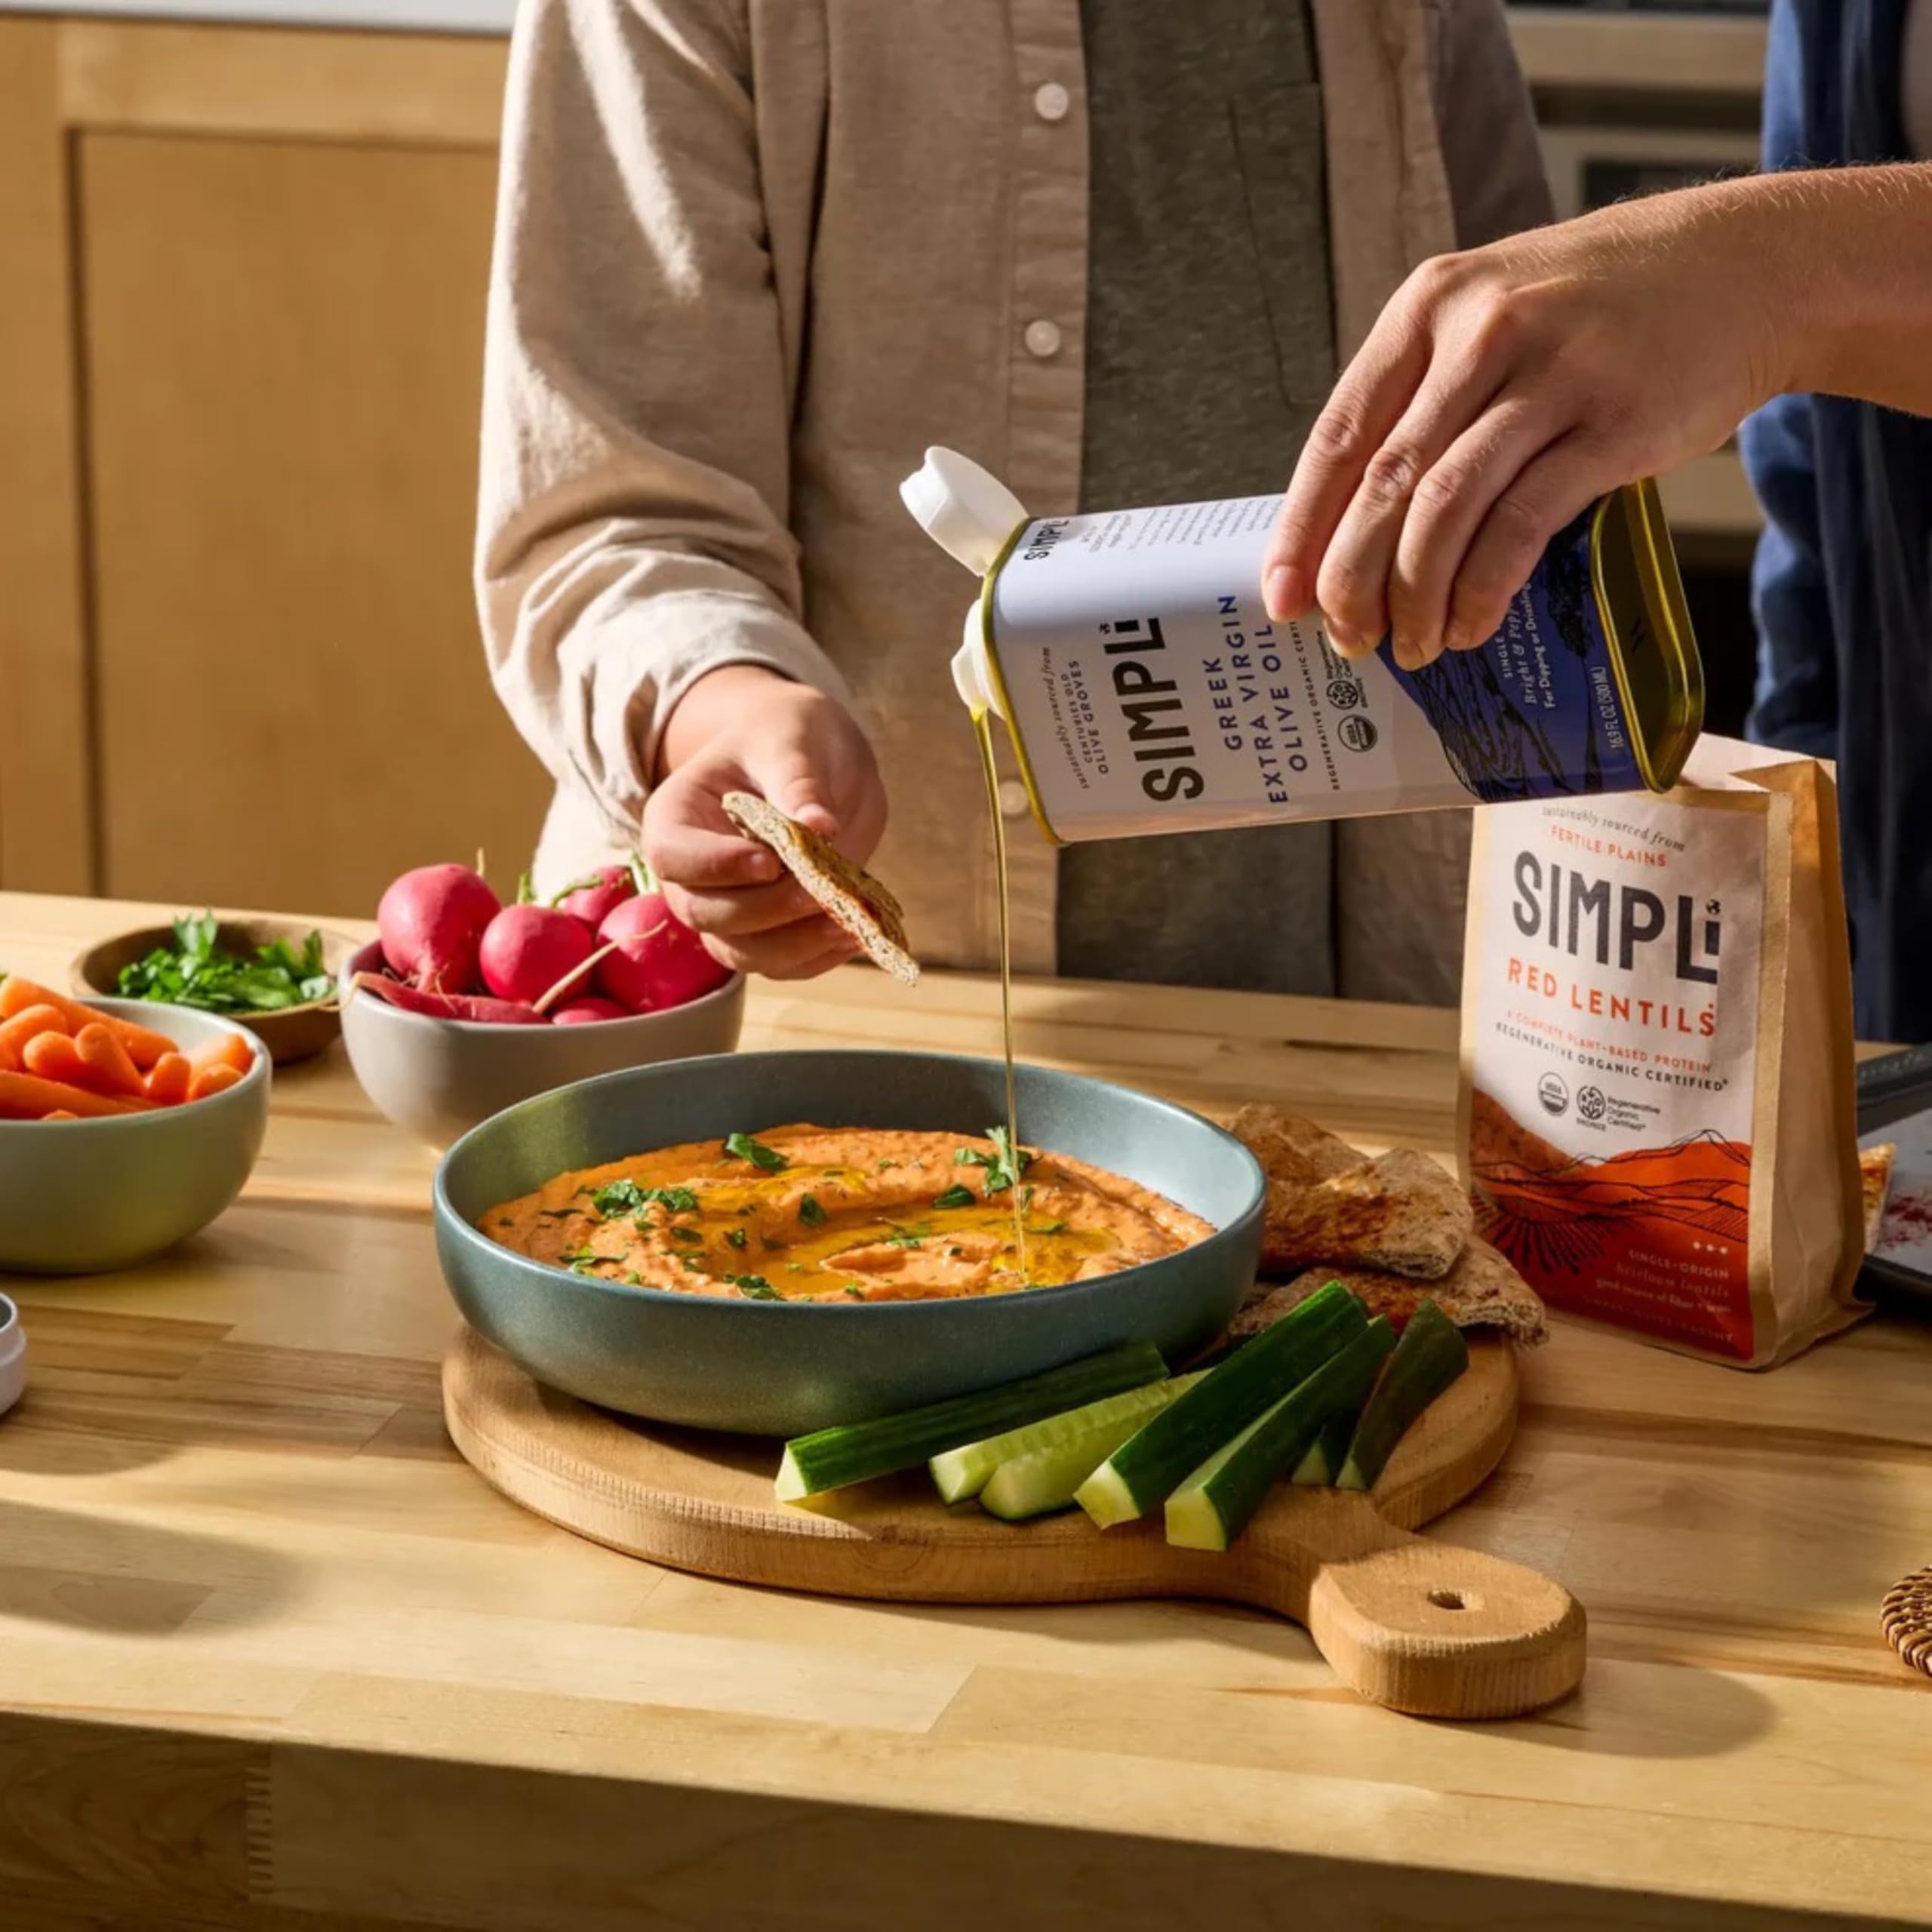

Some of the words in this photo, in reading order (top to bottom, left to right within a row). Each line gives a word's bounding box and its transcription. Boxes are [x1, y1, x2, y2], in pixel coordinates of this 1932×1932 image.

[1218, 596, 1259, 702] VIRGIN
[1254, 624, 1281, 672] OIL
[1289, 622, 1304, 652] CERTI
[1512, 644, 1524, 656] &
[1531, 633, 1540, 644] or
[1041, 648, 1055, 676] from
[1299, 657, 1318, 706] ORGANIC
[1518, 661, 1537, 703] Bright
[1535, 646, 1551, 688] Dipping
[1043, 678, 1062, 721] sourced
[1061, 674, 1073, 696] OLD
[1069, 660, 1094, 722] GROVES
[1202, 658, 1242, 750] GREEK
[1543, 691, 1555, 708] For
[1069, 701, 1093, 763] CENTURIES
[1088, 729, 1109, 774] OLIVE
[1270, 687, 1307, 772] OLIVE
[1313, 712, 1340, 790] REGENERATIVE
[1249, 715, 1288, 803] EXTRA
[1543, 807, 1599, 826] sustainably
[1603, 818, 1649, 840] sourced
[1650, 832, 1685, 852] from
[1551, 825, 1602, 854] FERTILE
[1607, 843, 1667, 867] PLAINS
[1507, 958, 1558, 998] RED
[1571, 984, 1715, 1037] LENTILS
[1496, 1021, 1573, 1060] REGENERATIVE
[1578, 1054, 1640, 1078] ORGANIC
[1654, 1054, 1712, 1074] PROTEIN
